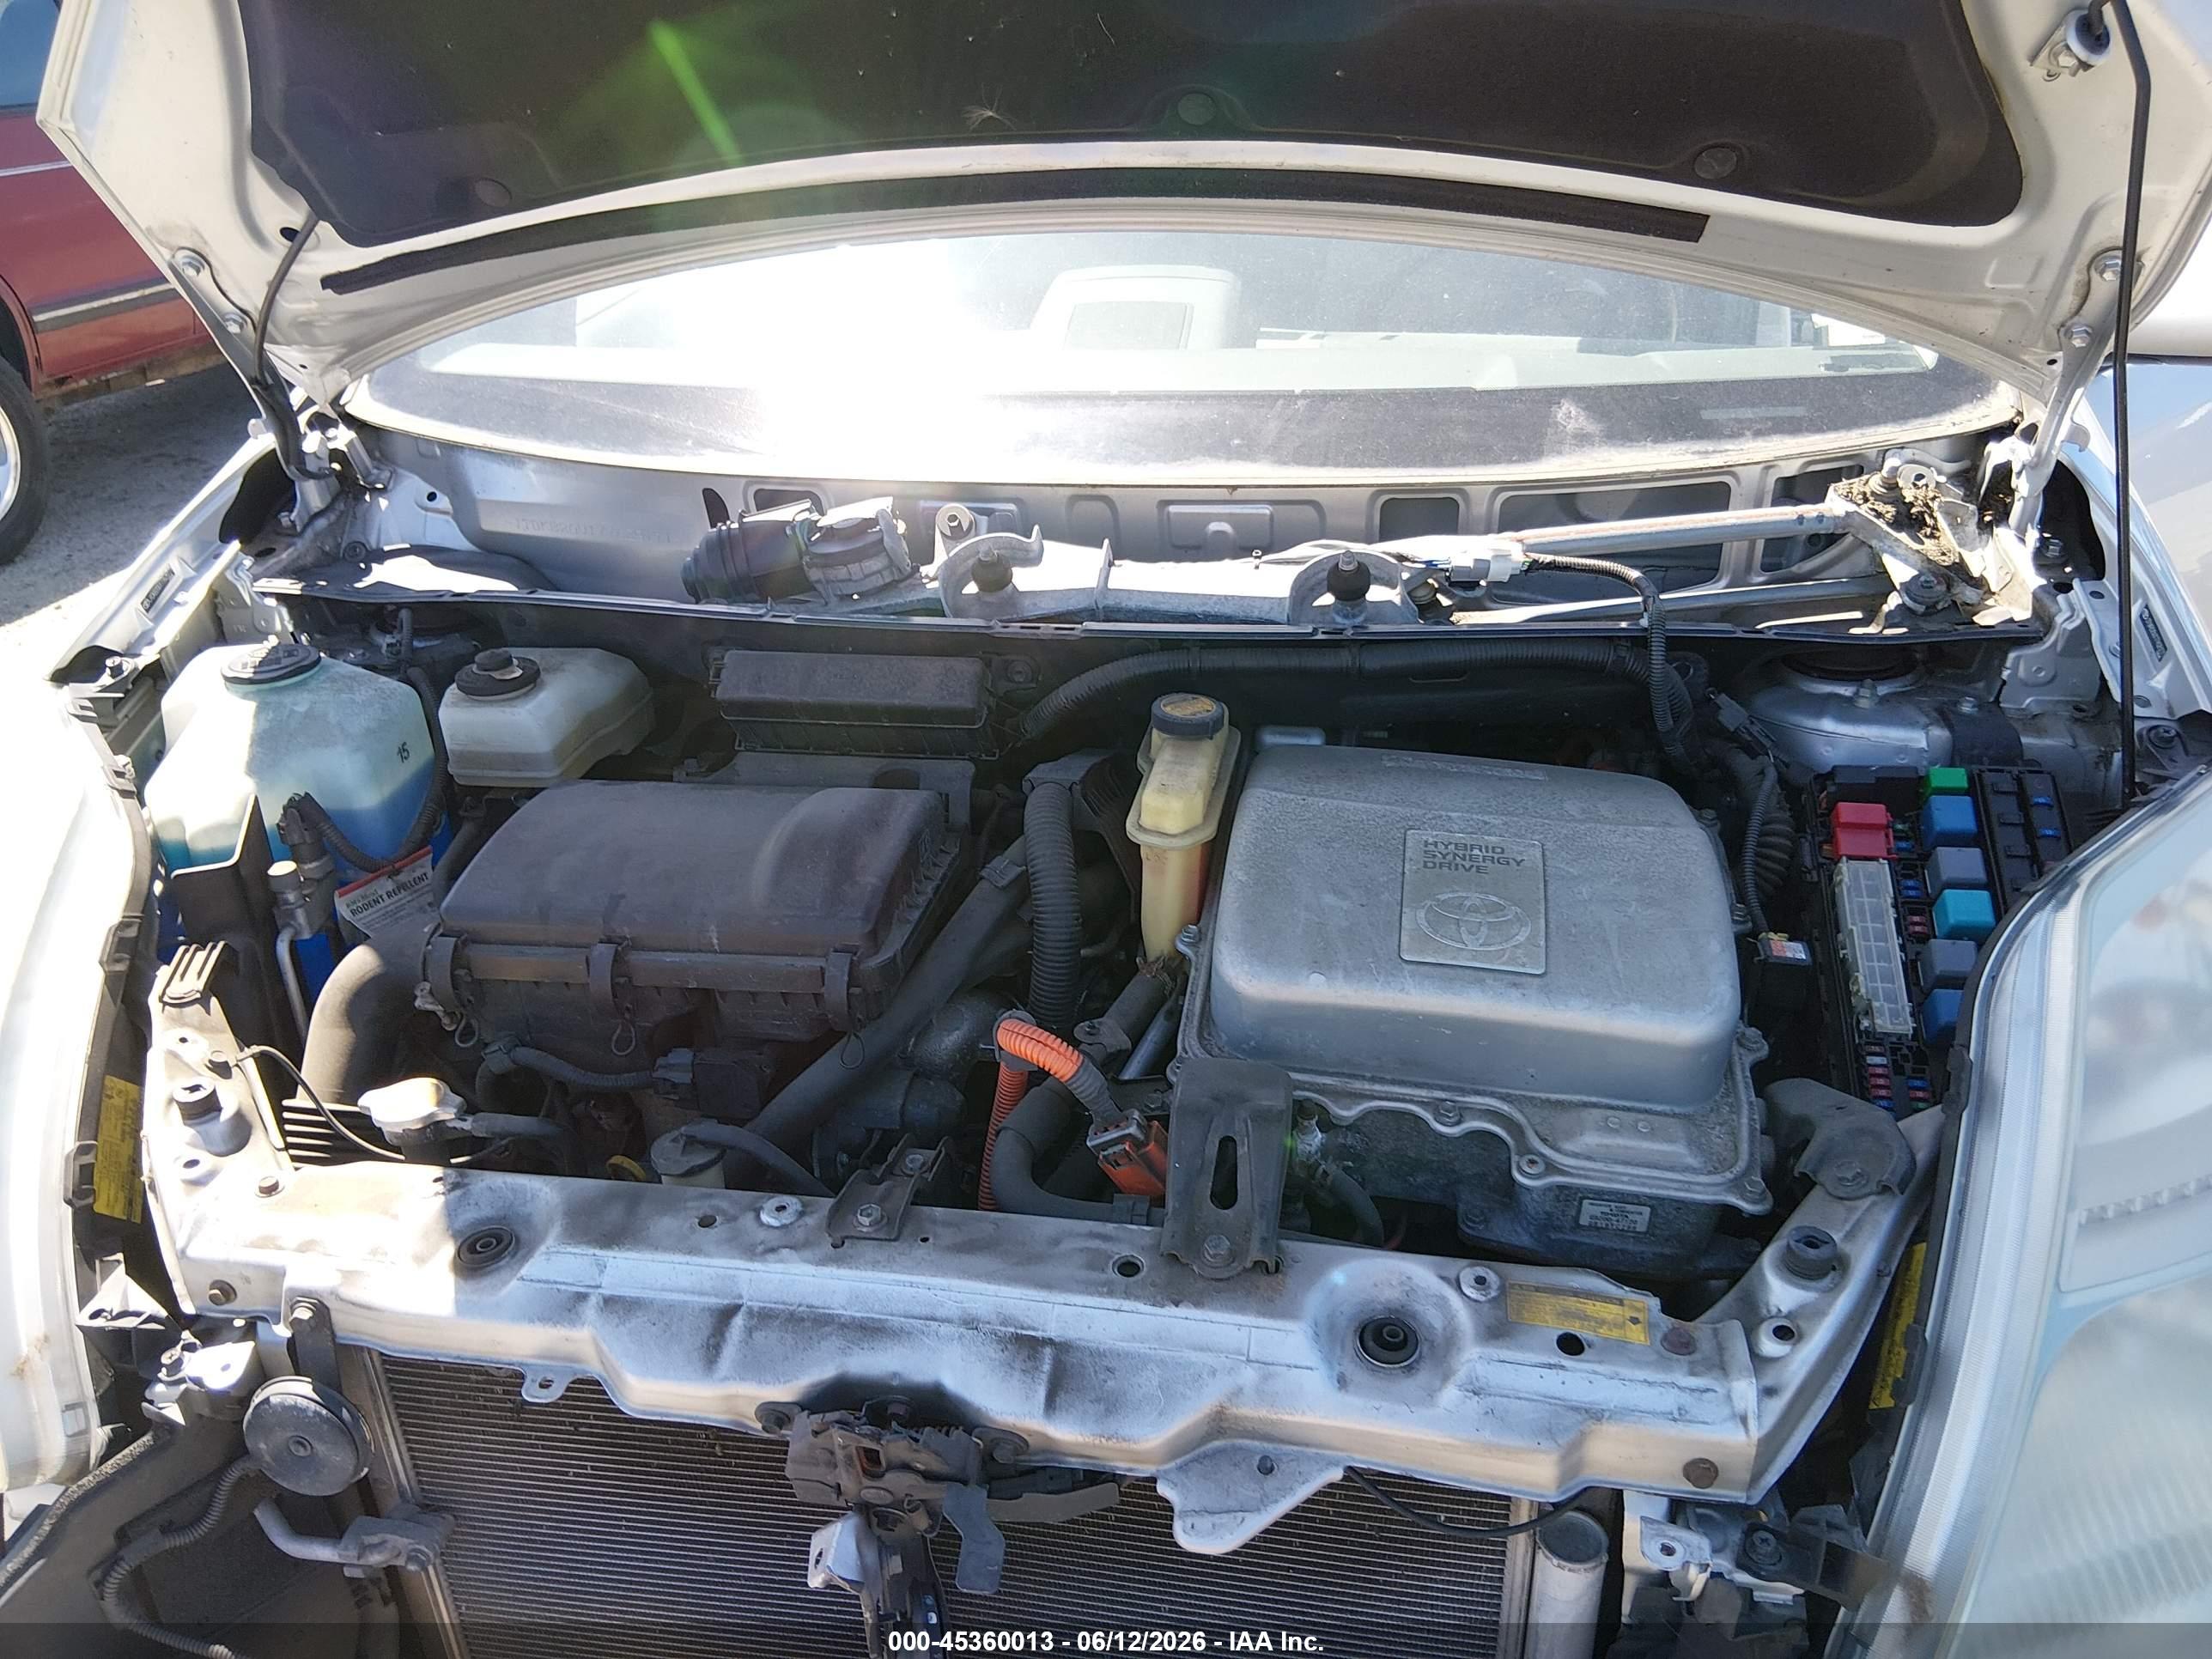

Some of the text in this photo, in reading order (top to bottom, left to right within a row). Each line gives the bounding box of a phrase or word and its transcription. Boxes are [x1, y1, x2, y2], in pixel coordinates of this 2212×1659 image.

[1424, 840, 1505, 855] HYBRID
[1424, 850, 1526, 867] SYNERGY
[1423, 860, 1489, 874] DRIVE
[349, 895, 386, 918] RODENT
[385, 872, 429, 901] REPELLENT
